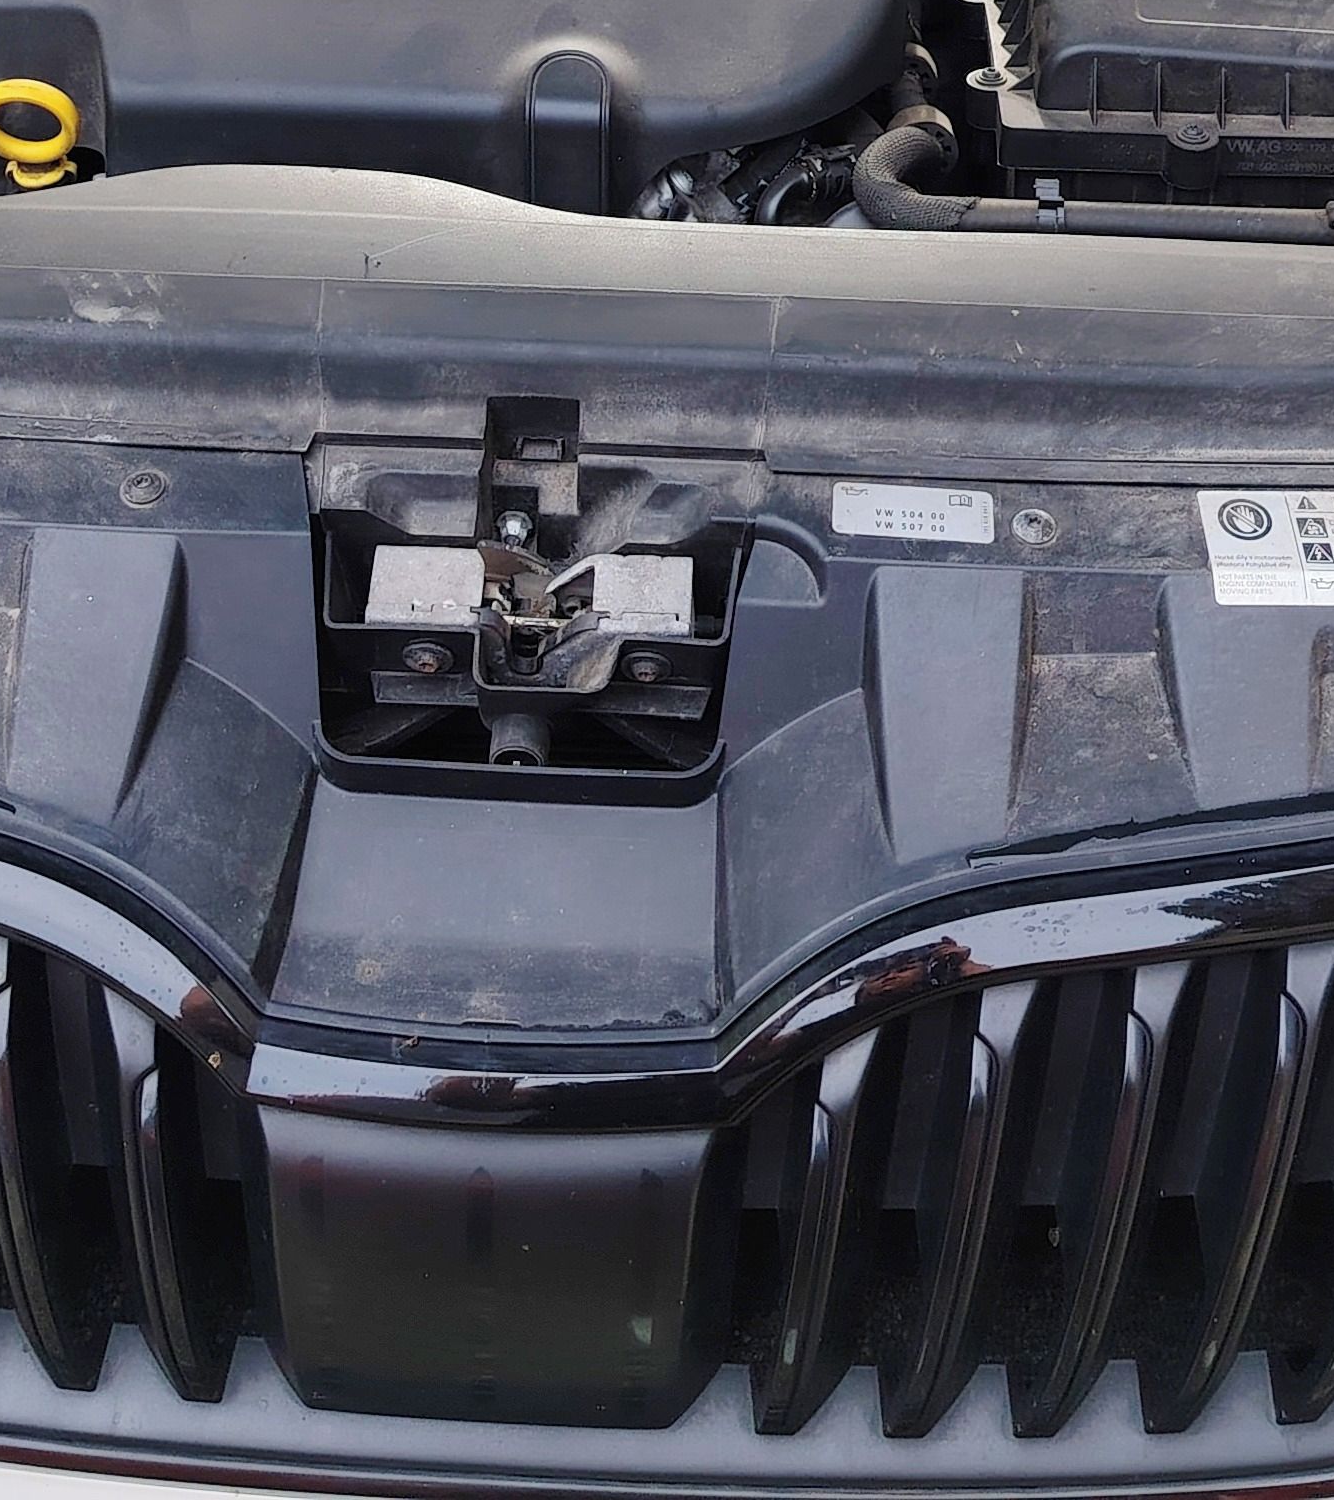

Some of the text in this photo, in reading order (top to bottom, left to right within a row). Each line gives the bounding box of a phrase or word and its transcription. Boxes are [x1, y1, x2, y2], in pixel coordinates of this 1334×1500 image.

[1226, 139, 1254, 153] VW
[1256, 139, 1282, 154] AG
[875, 508, 945, 521] VW 504 00
[875, 520, 945, 533] VW 507 00
